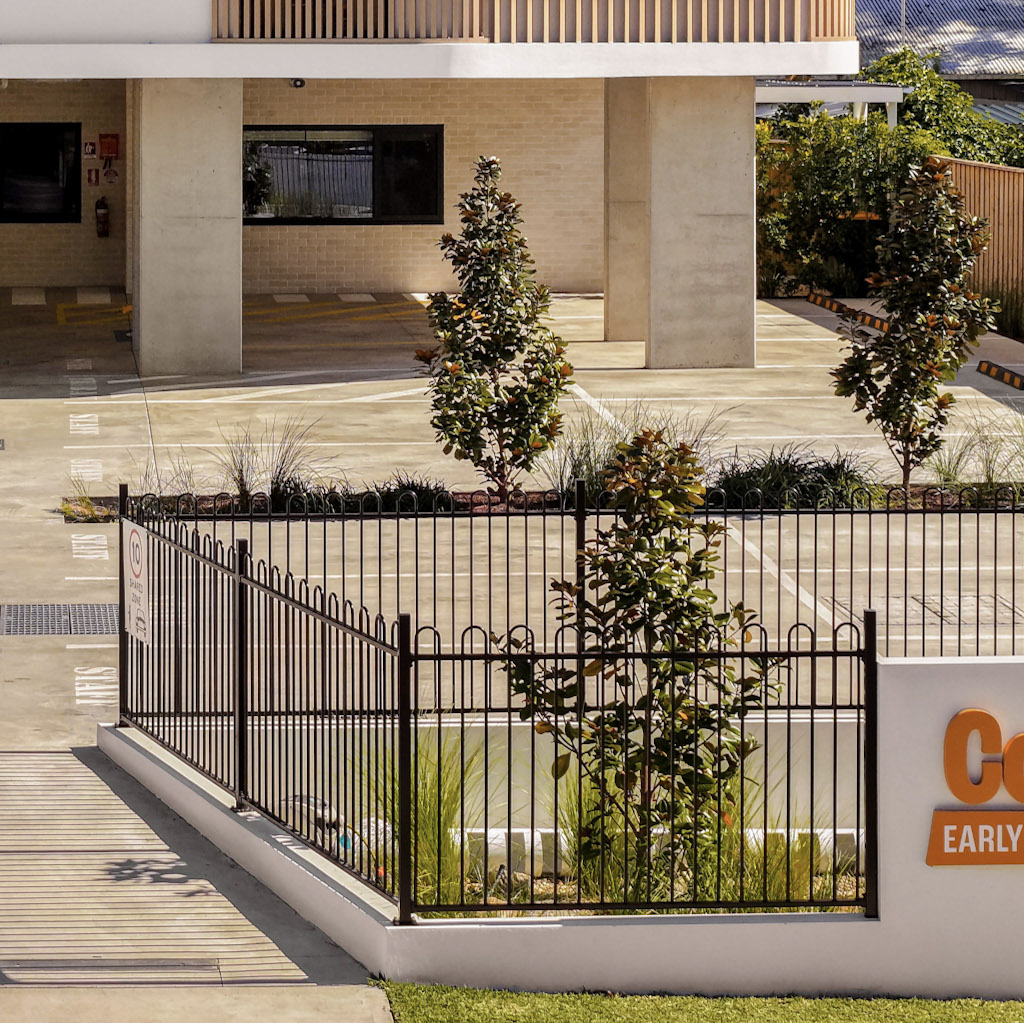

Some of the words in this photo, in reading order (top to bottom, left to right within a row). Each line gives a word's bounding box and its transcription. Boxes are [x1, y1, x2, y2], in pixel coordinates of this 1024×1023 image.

[132, 541, 140, 565] 10
[130, 578, 143, 594] SHARED
[74, 667, 118, 706] STAFF
[943, 825, 1023, 853] EARLY
